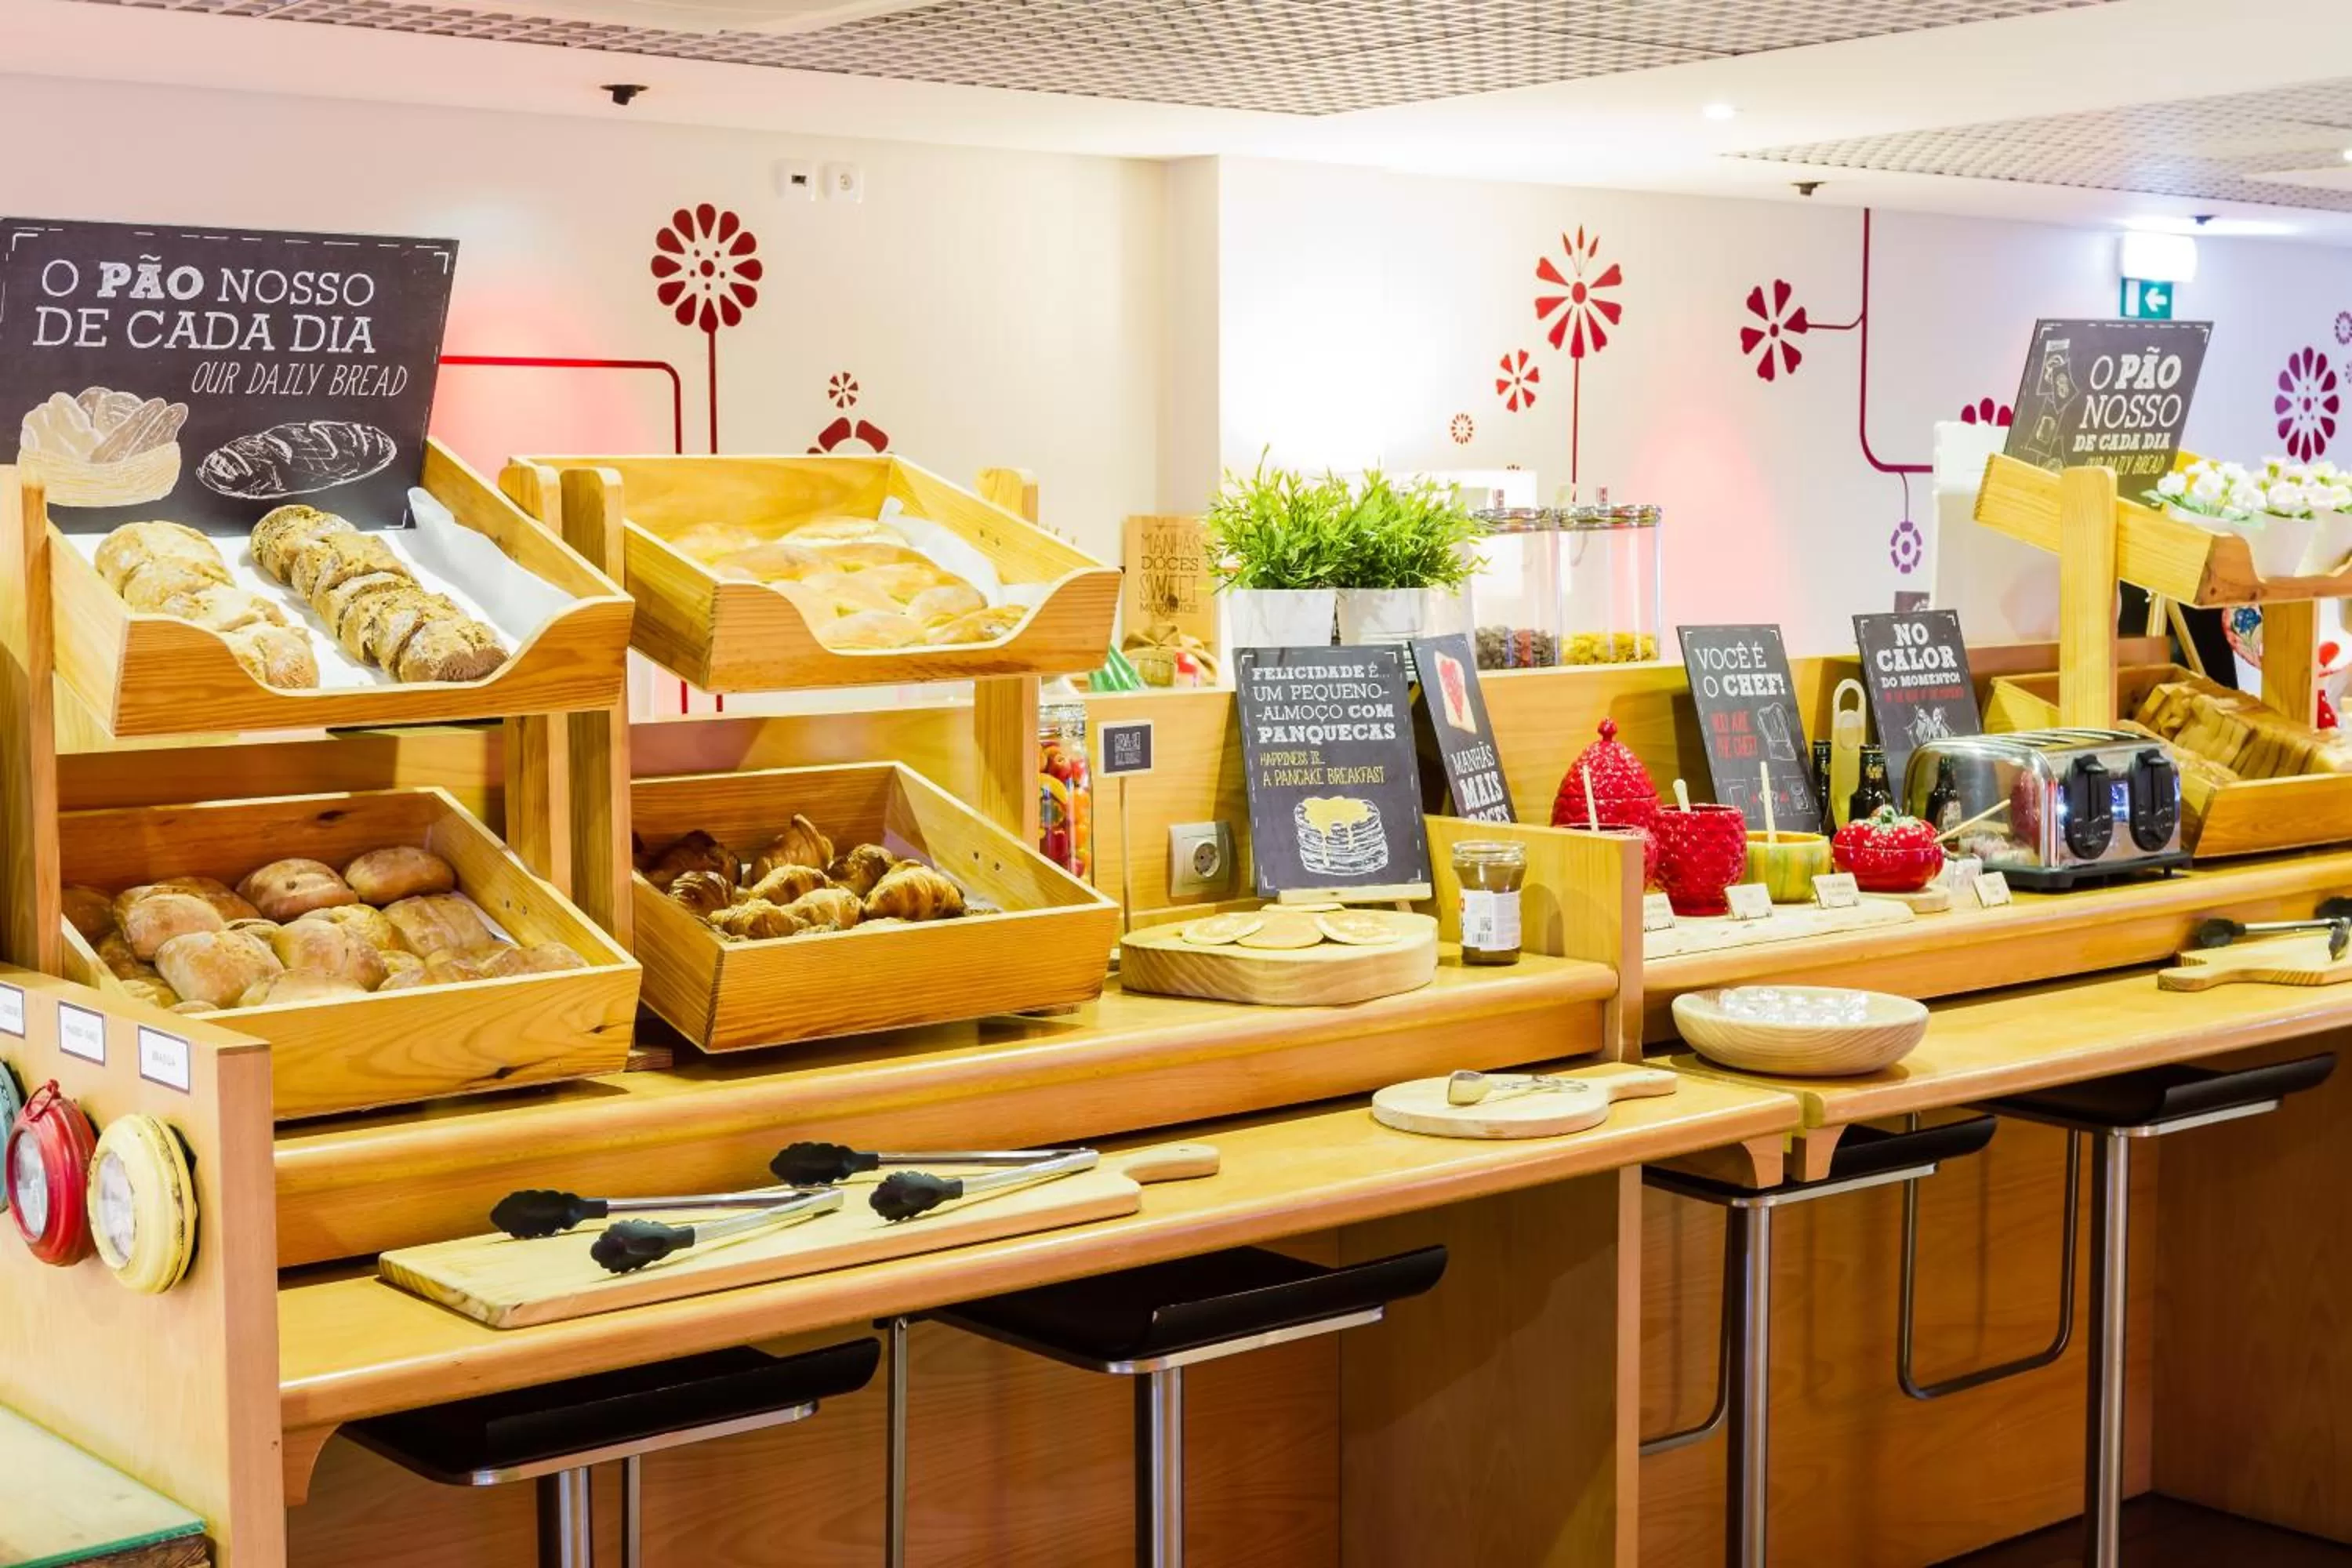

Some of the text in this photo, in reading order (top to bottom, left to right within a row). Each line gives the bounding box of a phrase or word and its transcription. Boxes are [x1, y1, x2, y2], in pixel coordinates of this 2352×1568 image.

[42, 253, 376, 307] O PÃO NOSSO
[33, 307, 376, 354] DE CADA DIA
[191, 361, 408, 397] OUR DAILY BREAD
[2089, 346, 2182, 390] O PÃO
[2078, 394, 2182, 430] NOSSO
[2072, 432, 2171, 452] DE CADA DIA
[1142, 556, 1199, 571] DOCES
[1893, 622, 1929, 646] NO
[1695, 641, 1767, 670] VOCÊ É
[1876, 645, 1958, 672] CALOR
[1251, 665, 1365, 681] FELICIDADE
[1880, 670, 1961, 688] DO MOMENTO!
[1253, 683, 1390, 702] UM PEQUENO-
[1703, 673, 1786, 698] O CHEF!
[1255, 703, 1395, 723] -ALMOÇO COM
[1257, 723, 1396, 746] PANQUECAS
[1260, 750, 1308, 767] HAPPINESS
[1450, 740, 1495, 775] MANHÃS
[1263, 766, 1385, 787] A PANCAKE BREAKFAST
[1458, 771, 1504, 811] MAIS
